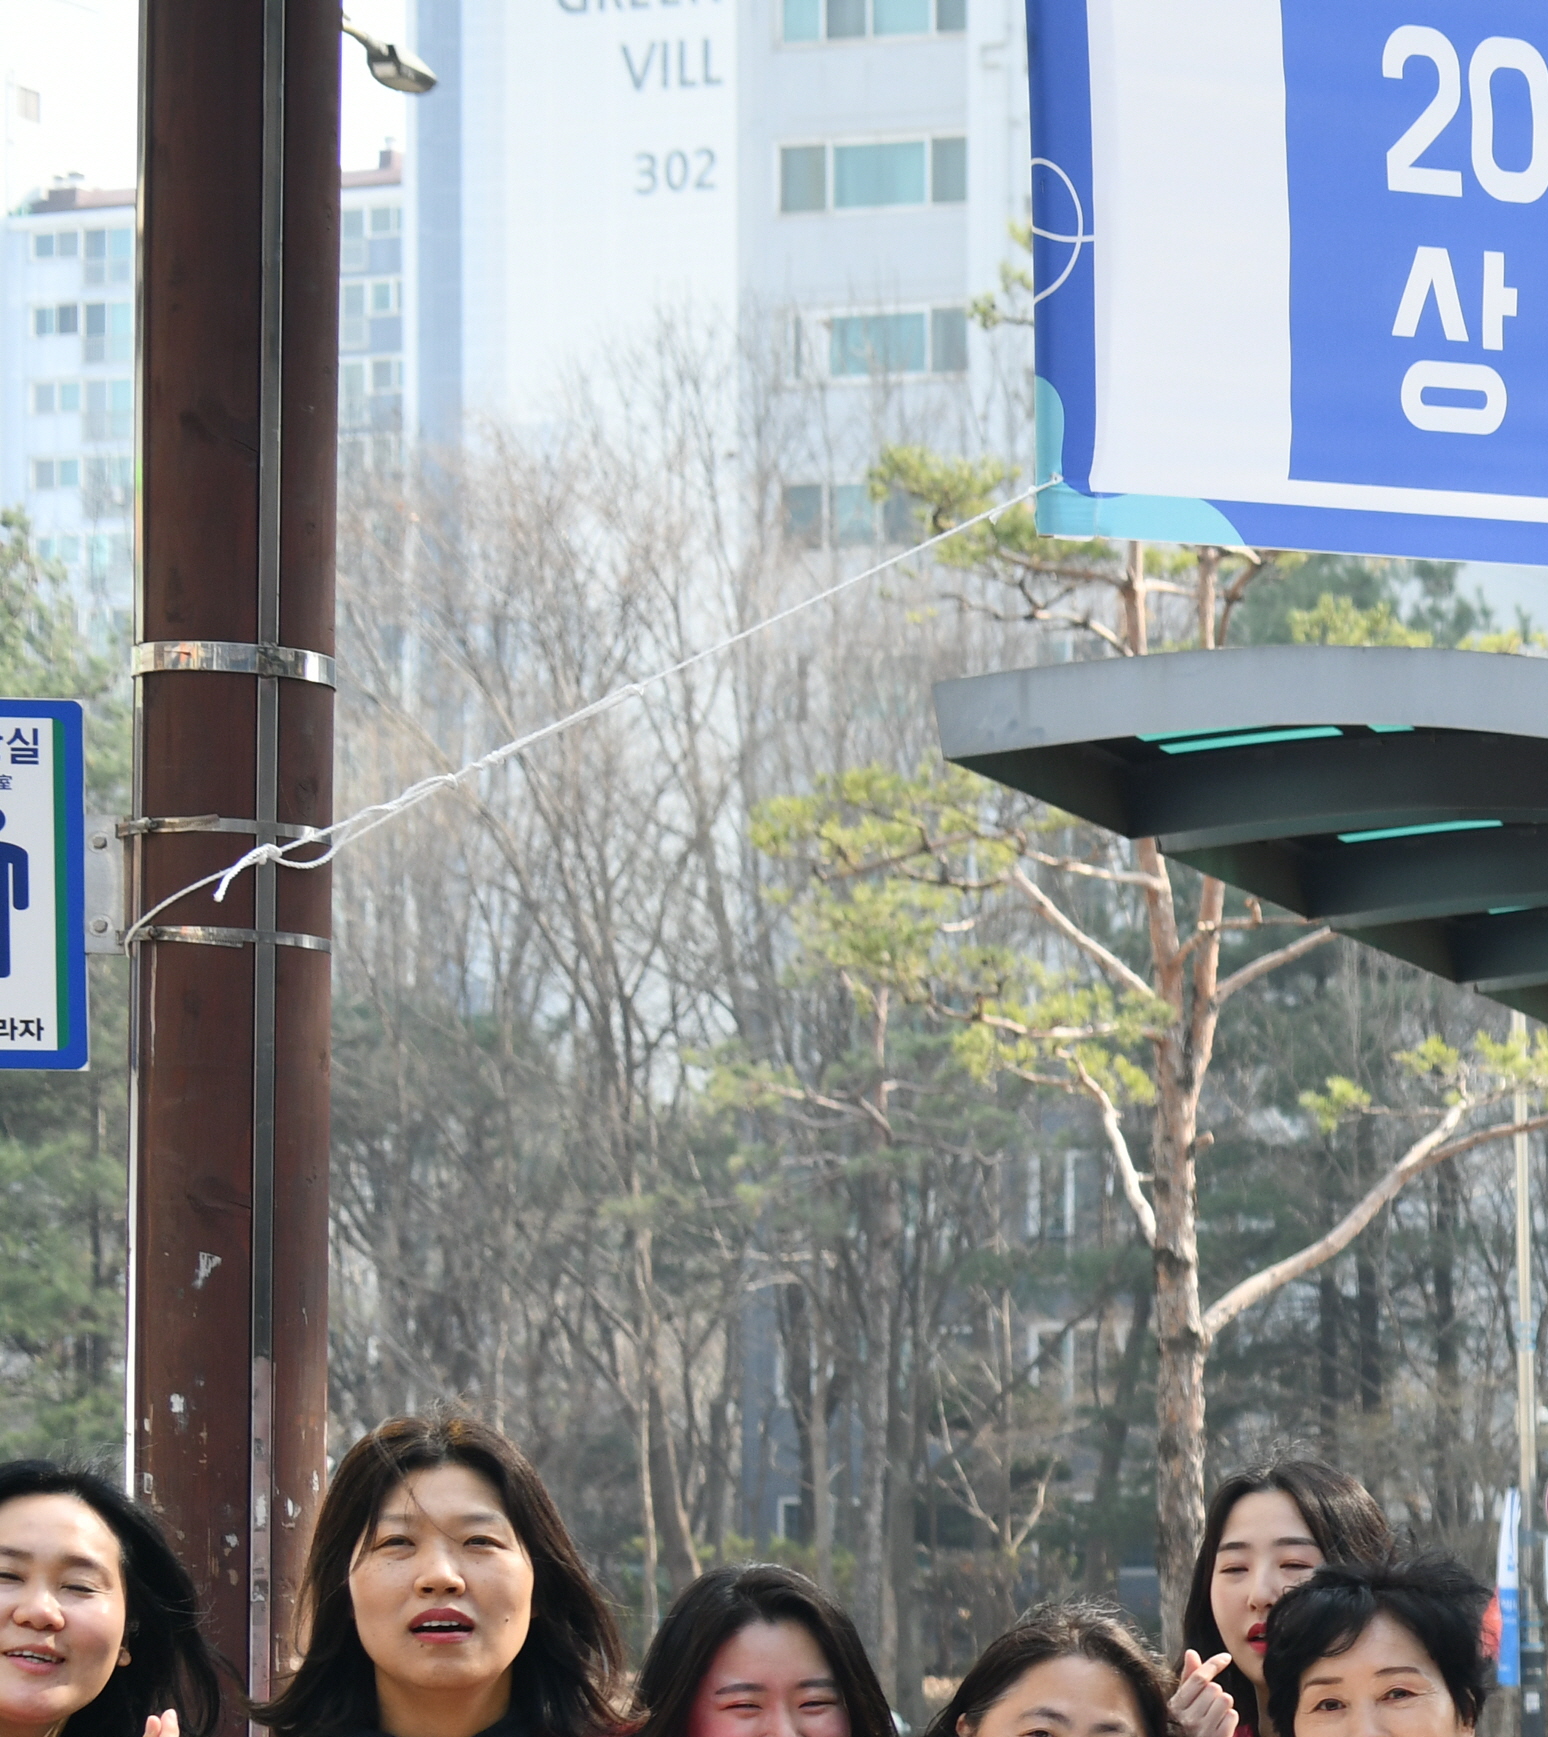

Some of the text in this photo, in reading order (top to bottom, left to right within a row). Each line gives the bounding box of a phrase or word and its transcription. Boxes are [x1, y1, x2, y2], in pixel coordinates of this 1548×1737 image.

[620, 38, 723, 91] VILL
[635, 148, 716, 195] 302
[0, 728, 39, 765] 실
